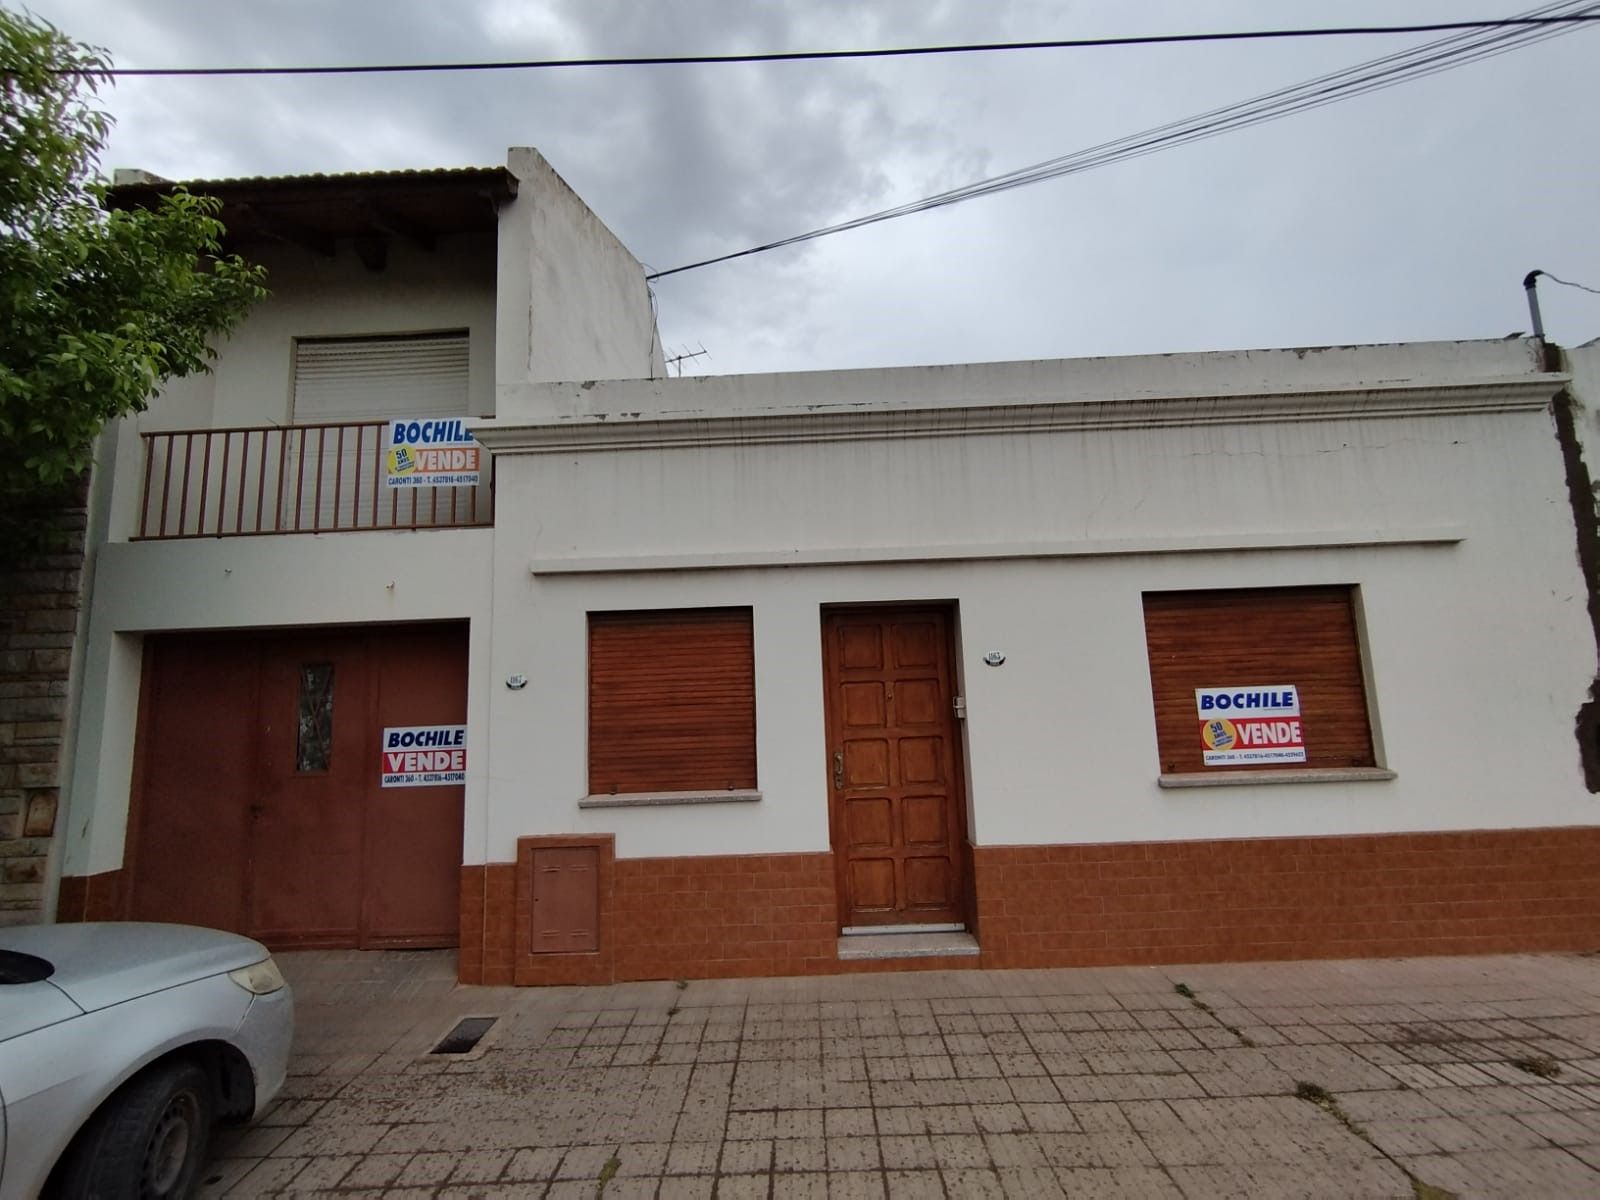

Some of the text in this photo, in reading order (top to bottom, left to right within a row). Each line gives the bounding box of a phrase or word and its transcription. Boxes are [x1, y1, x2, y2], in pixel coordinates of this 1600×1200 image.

[395, 448, 408, 460] 50
[415, 449, 477, 471] VENDE
[388, 476, 412, 485] CARONTI
[1201, 692, 1294, 710] BOCHILE
[1210, 722, 1223, 732] 50
[1236, 721, 1302, 745] VENDE
[388, 730, 465, 748] BOCHILE
[387, 751, 464, 772] VENDE
[384, 775, 405, 783] CARONTI
